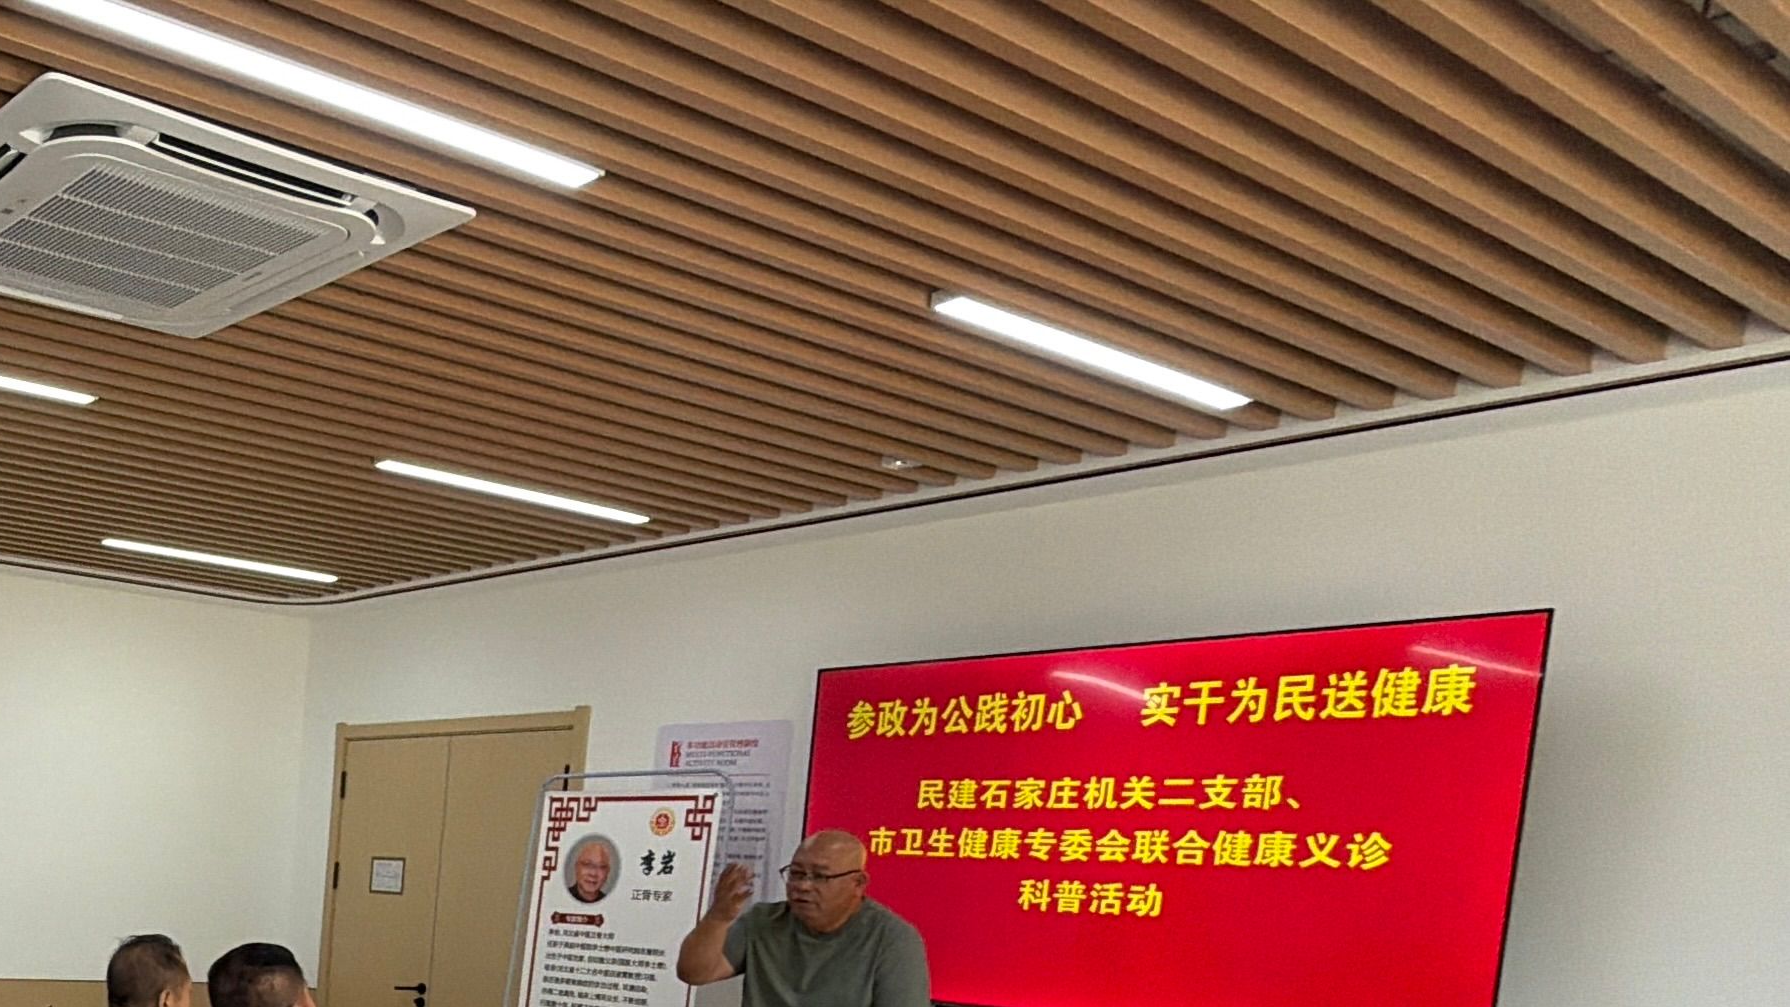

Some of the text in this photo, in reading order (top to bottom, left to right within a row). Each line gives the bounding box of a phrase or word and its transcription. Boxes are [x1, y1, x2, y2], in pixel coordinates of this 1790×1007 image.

[846, 663, 1477, 740] 参政为公践初心 实干为民送健康
[639, 849, 676, 876] 李岩
[869, 827, 1393, 871] 市卫生健康专委会联合健康义诊
[631, 889, 673, 902] 正骨专家
[1018, 879, 1164, 918] 科普活动
